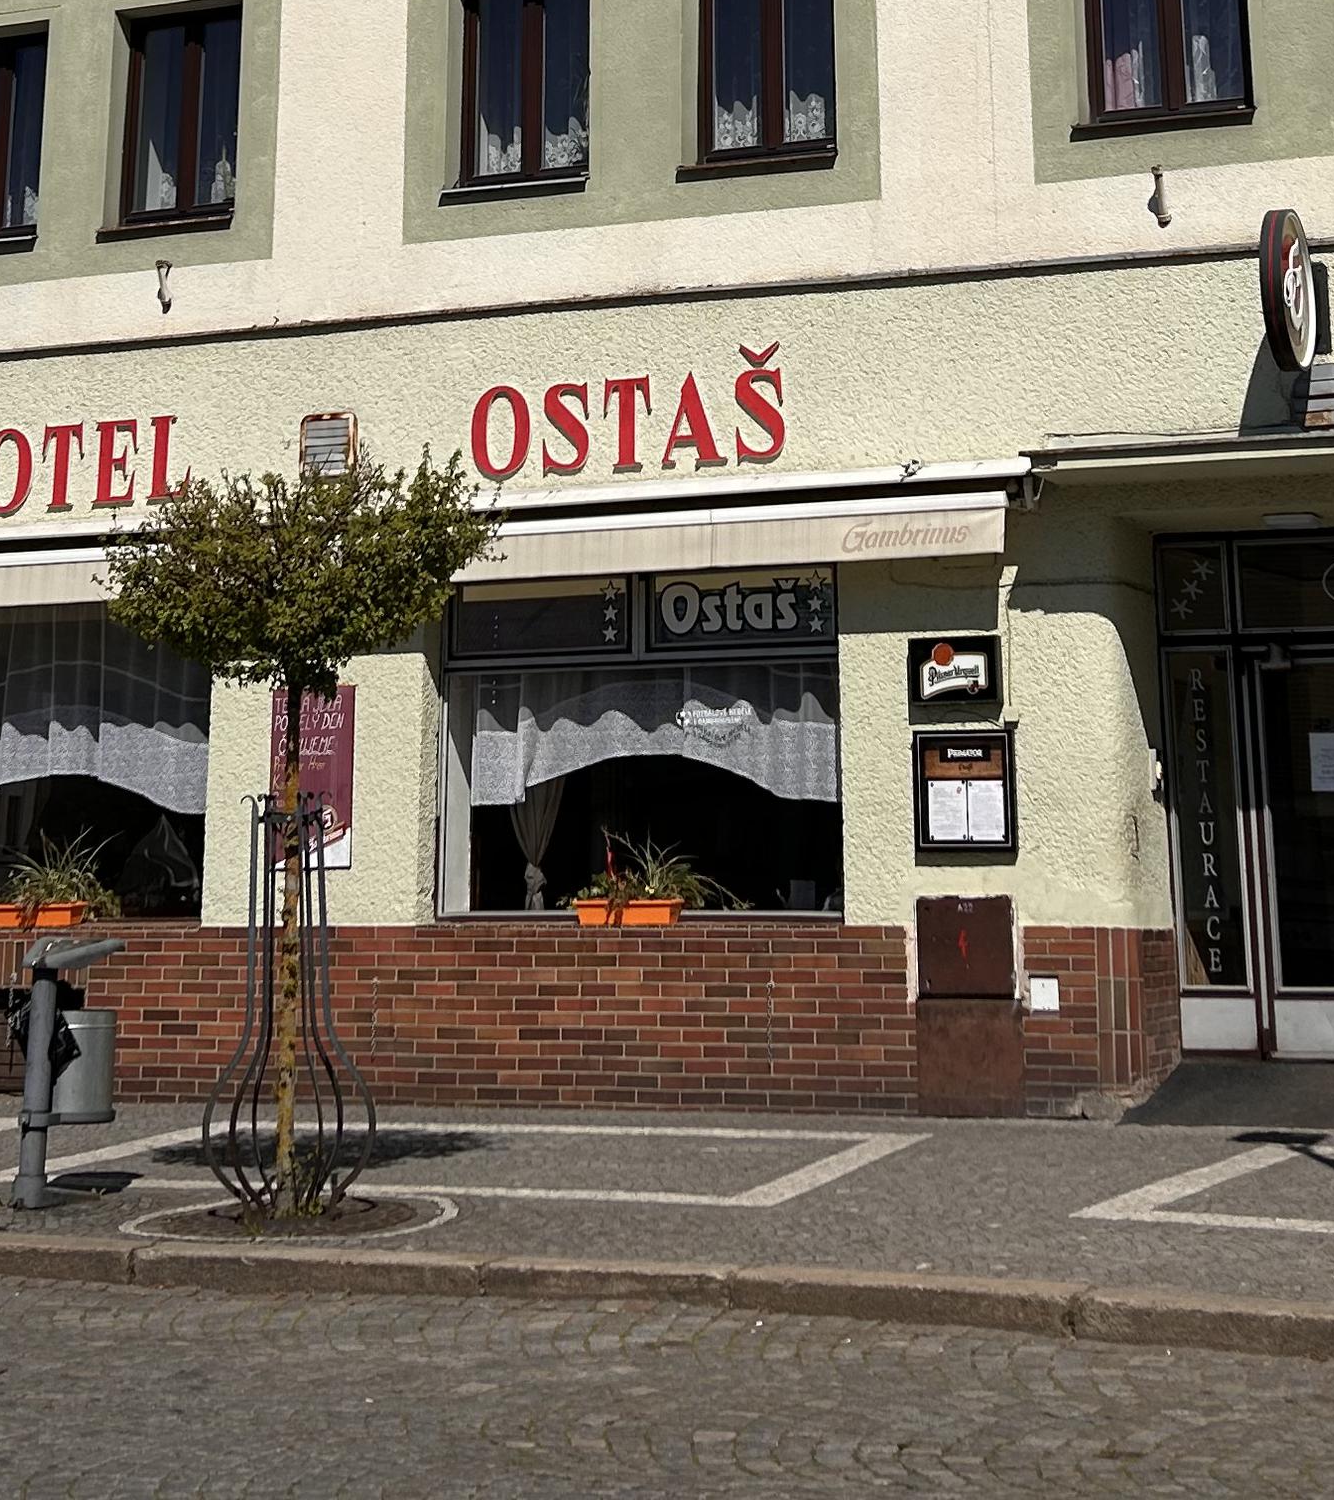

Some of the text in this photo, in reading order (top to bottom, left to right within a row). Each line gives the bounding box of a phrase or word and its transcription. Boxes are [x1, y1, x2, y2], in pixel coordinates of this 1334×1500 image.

[471, 340, 786, 480] OSTAŠ
[841, 520, 972, 553] Gambrinus
[661, 578, 800, 635] Ostaš
[1189, 667, 1223, 973] RESTAURACE
